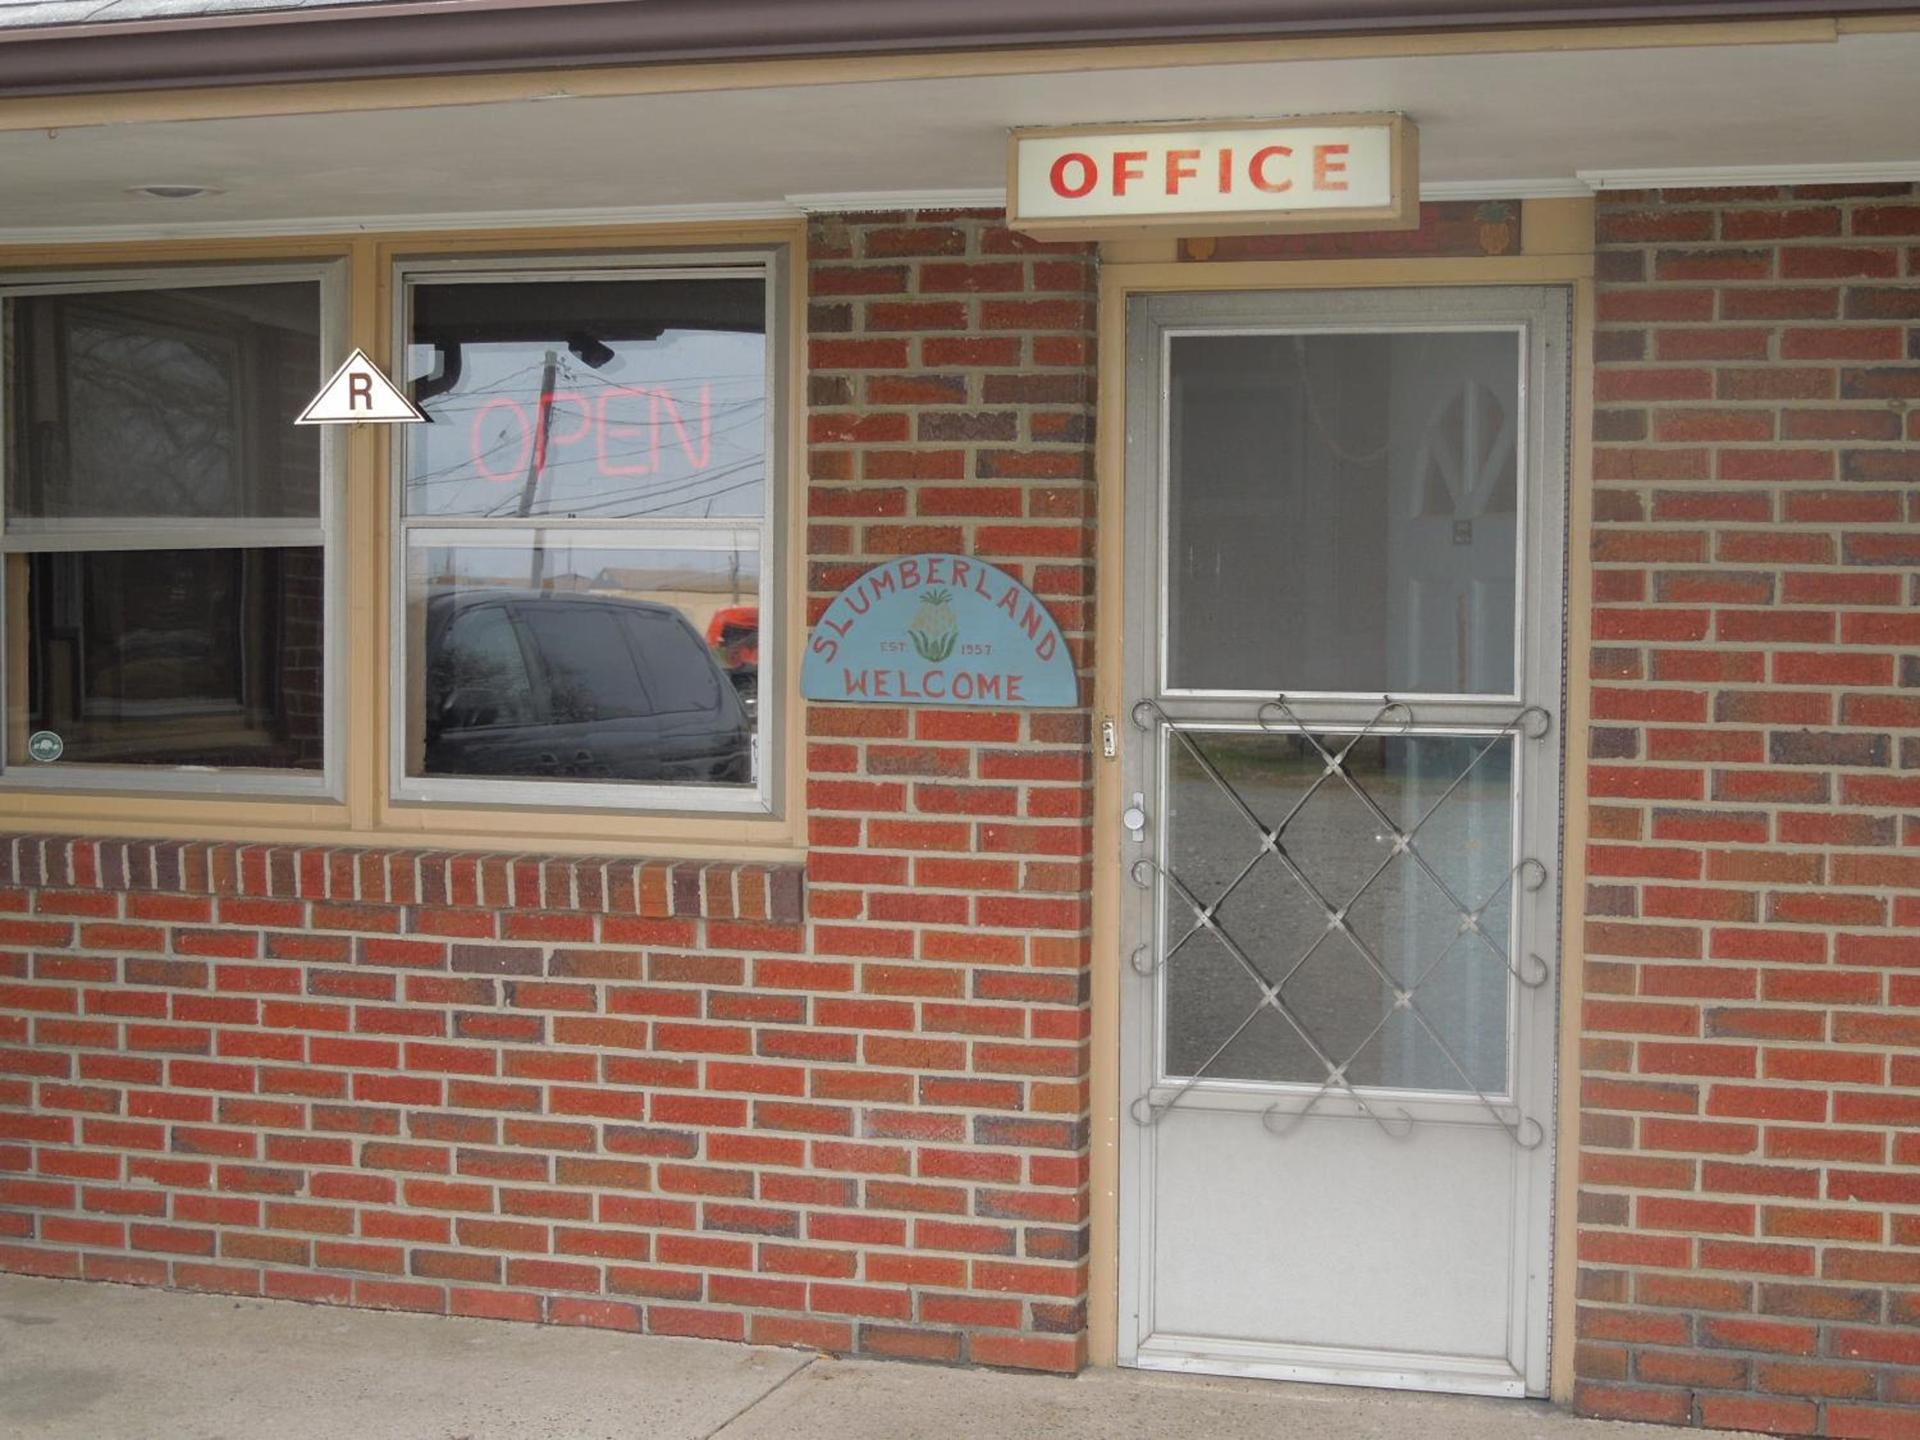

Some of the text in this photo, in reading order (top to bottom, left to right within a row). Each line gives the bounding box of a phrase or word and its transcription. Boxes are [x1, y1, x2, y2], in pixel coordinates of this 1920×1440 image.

[1049, 143, 1350, 199] OFFICE
[348, 372, 374, 411] R
[470, 383, 712, 483] OPEN
[812, 557, 1057, 664] SLUMBERLAND
[880, 640, 993, 656] EST 1957
[843, 667, 1025, 701] WELCOME
